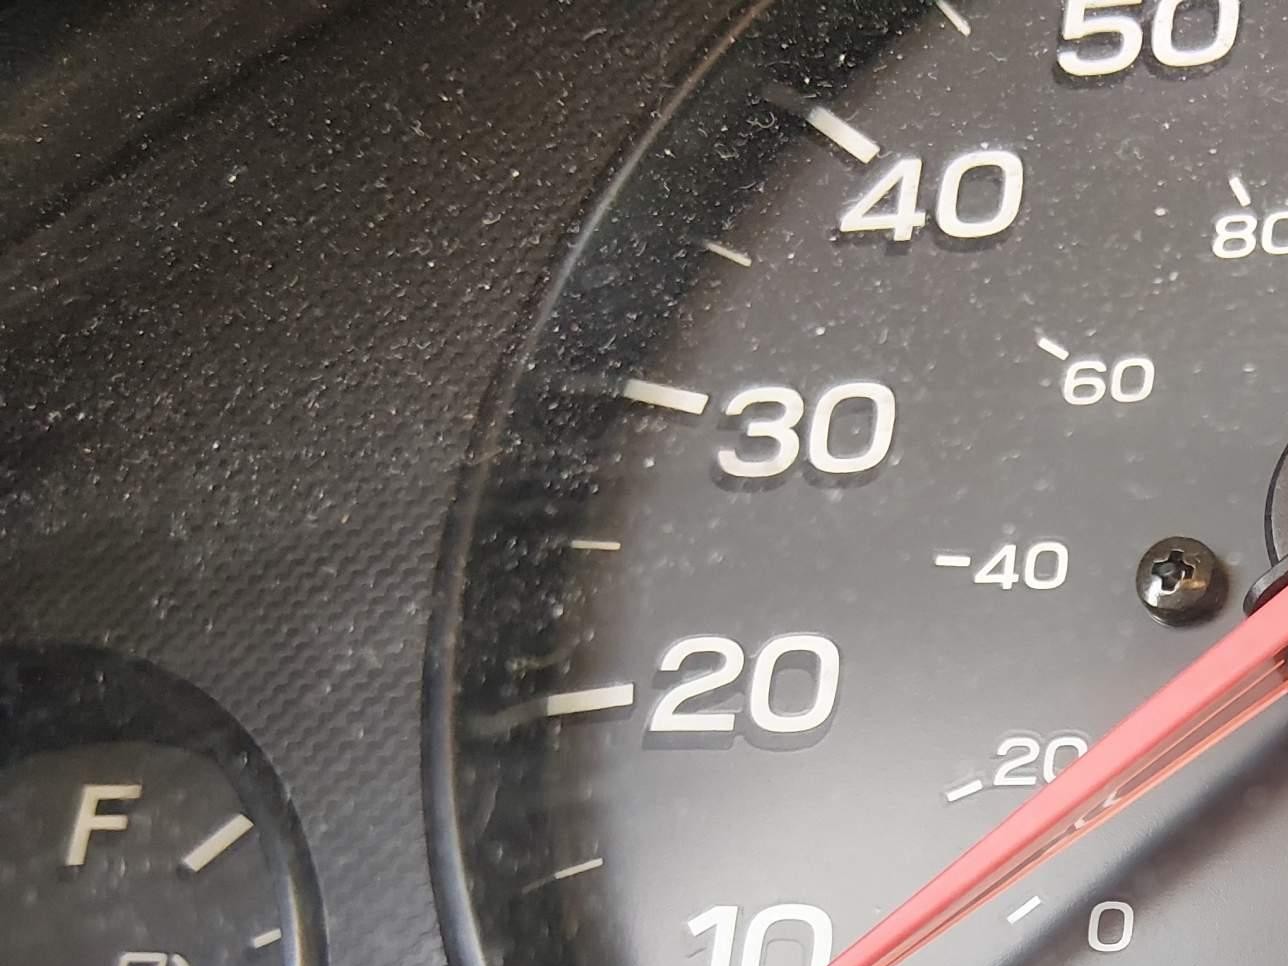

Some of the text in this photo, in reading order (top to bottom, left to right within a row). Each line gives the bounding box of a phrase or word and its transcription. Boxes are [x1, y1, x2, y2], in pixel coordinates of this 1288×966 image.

[1057, 0, 1240, 77] 50
[838, 150, 1024, 241] 40
[1063, 357, 1155, 405] 60
[717, 382, 896, 478] 30
[973, 542, 1069, 590] 40
[649, 633, 841, 733] 20
[992, 736, 1089, 787] 20
[66, 784, 142, 867] F
[1088, 901, 1135, 952] 0
